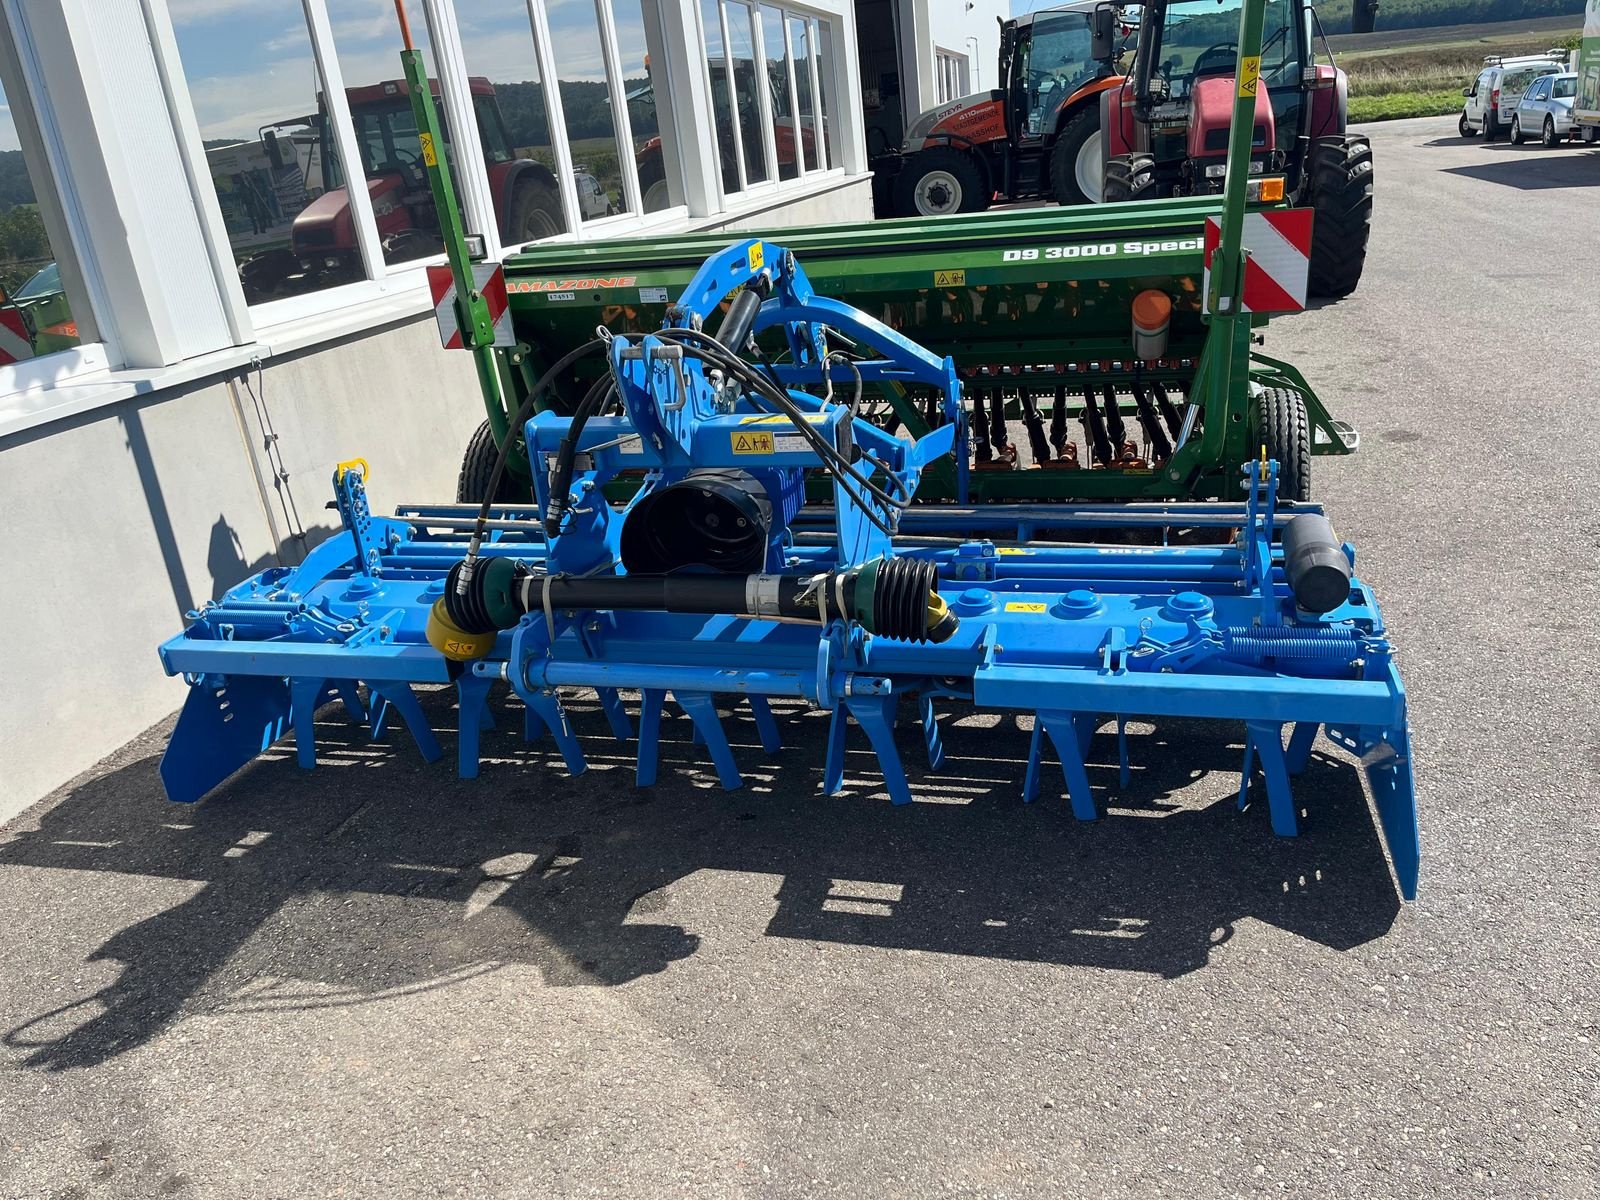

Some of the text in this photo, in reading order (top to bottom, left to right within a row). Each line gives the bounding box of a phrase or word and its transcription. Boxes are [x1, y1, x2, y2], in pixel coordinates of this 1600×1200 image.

[938, 104, 962, 120] STEYR
[1003, 237, 1204, 262] D9 3000 Speci
